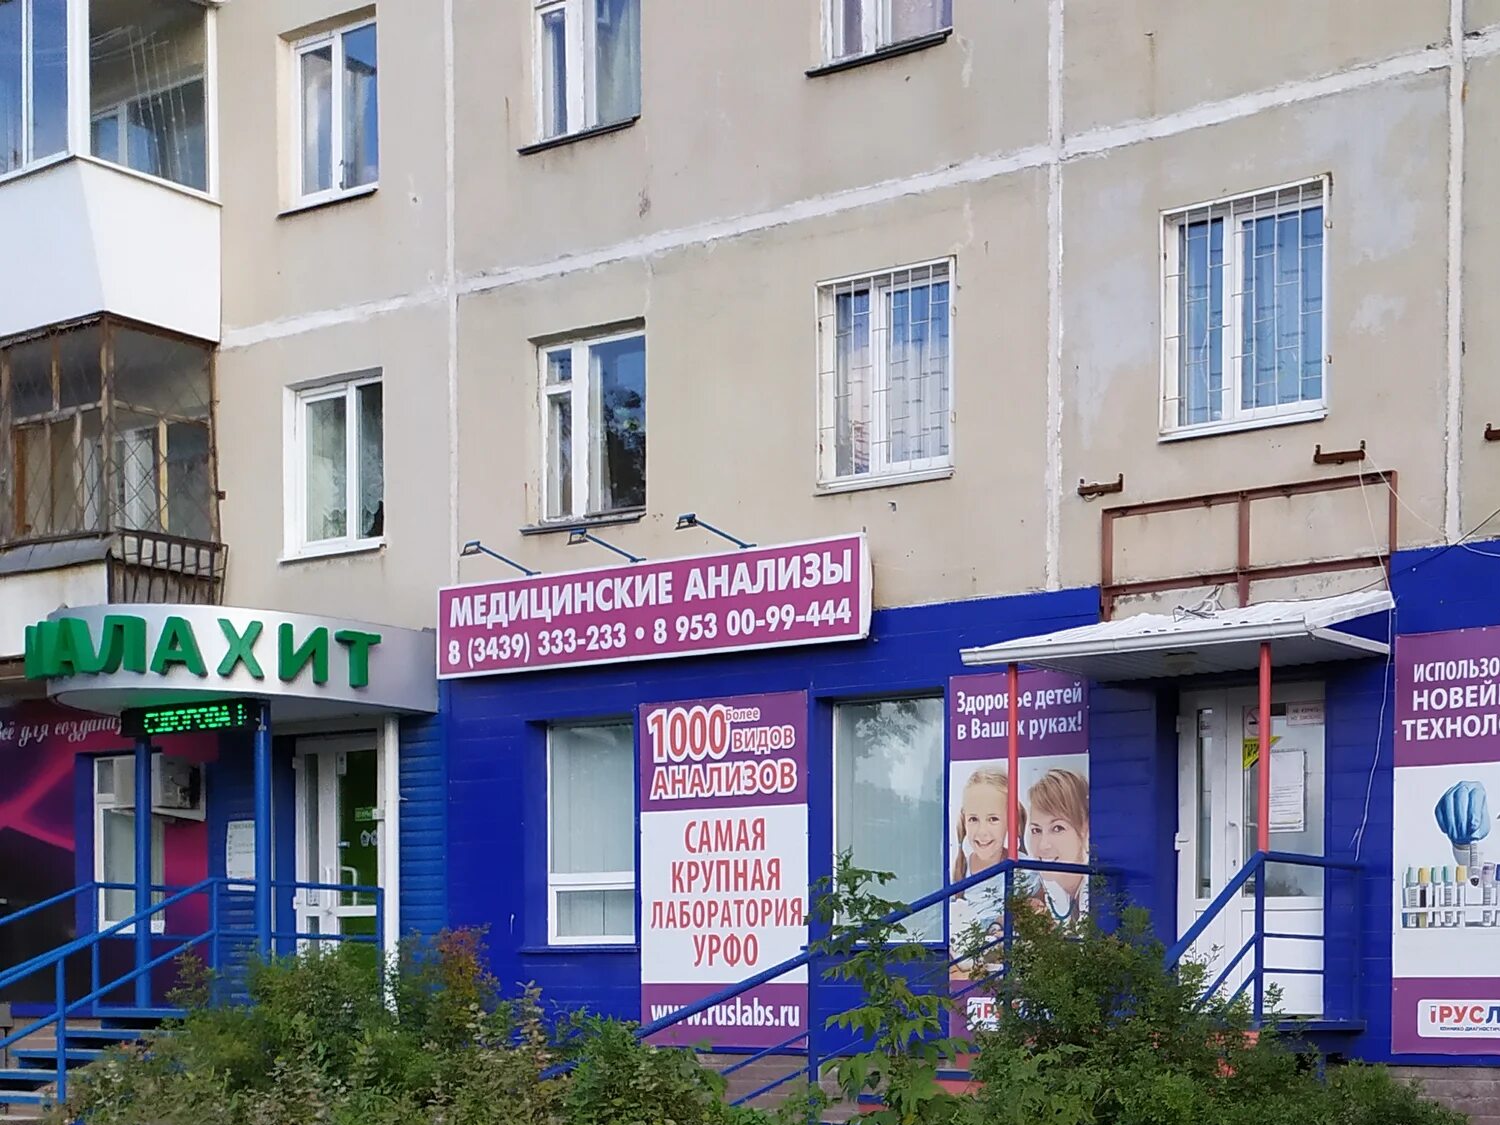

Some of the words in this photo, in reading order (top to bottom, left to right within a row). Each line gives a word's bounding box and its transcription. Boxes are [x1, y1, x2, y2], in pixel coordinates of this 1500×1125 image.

[449, 571, 673, 629] МЕДИЦИНСКИЕ
[683, 548, 853, 602] АНАЛИЗЫ
[448, 640, 461, 665] 8
[467, 634, 532, 669] (3439)
[537, 622, 627, 656] 333-233
[653, 617, 668, 644] 8
[675, 614, 718, 641] 953
[726, 597, 852, 637] 00-99-444
[1034, 681, 1082, 710] детей
[725, 707, 760, 721] Более
[957, 723, 967, 740] в
[970, 715, 1024, 739] Вашх
[1029, 710, 1082, 740] руках!
[648, 705, 728, 763] 1000
[732, 726, 795, 753] ВИДОВ
[650, 759, 798, 800] АНАЛИЗОВ
[684, 817, 766, 854] САМАЯ
[671, 858, 781, 893] КРУПНАЯ
[650, 897, 803, 930] ЛАБОРАТОРИЯ
[692, 933, 759, 968] УРФО
